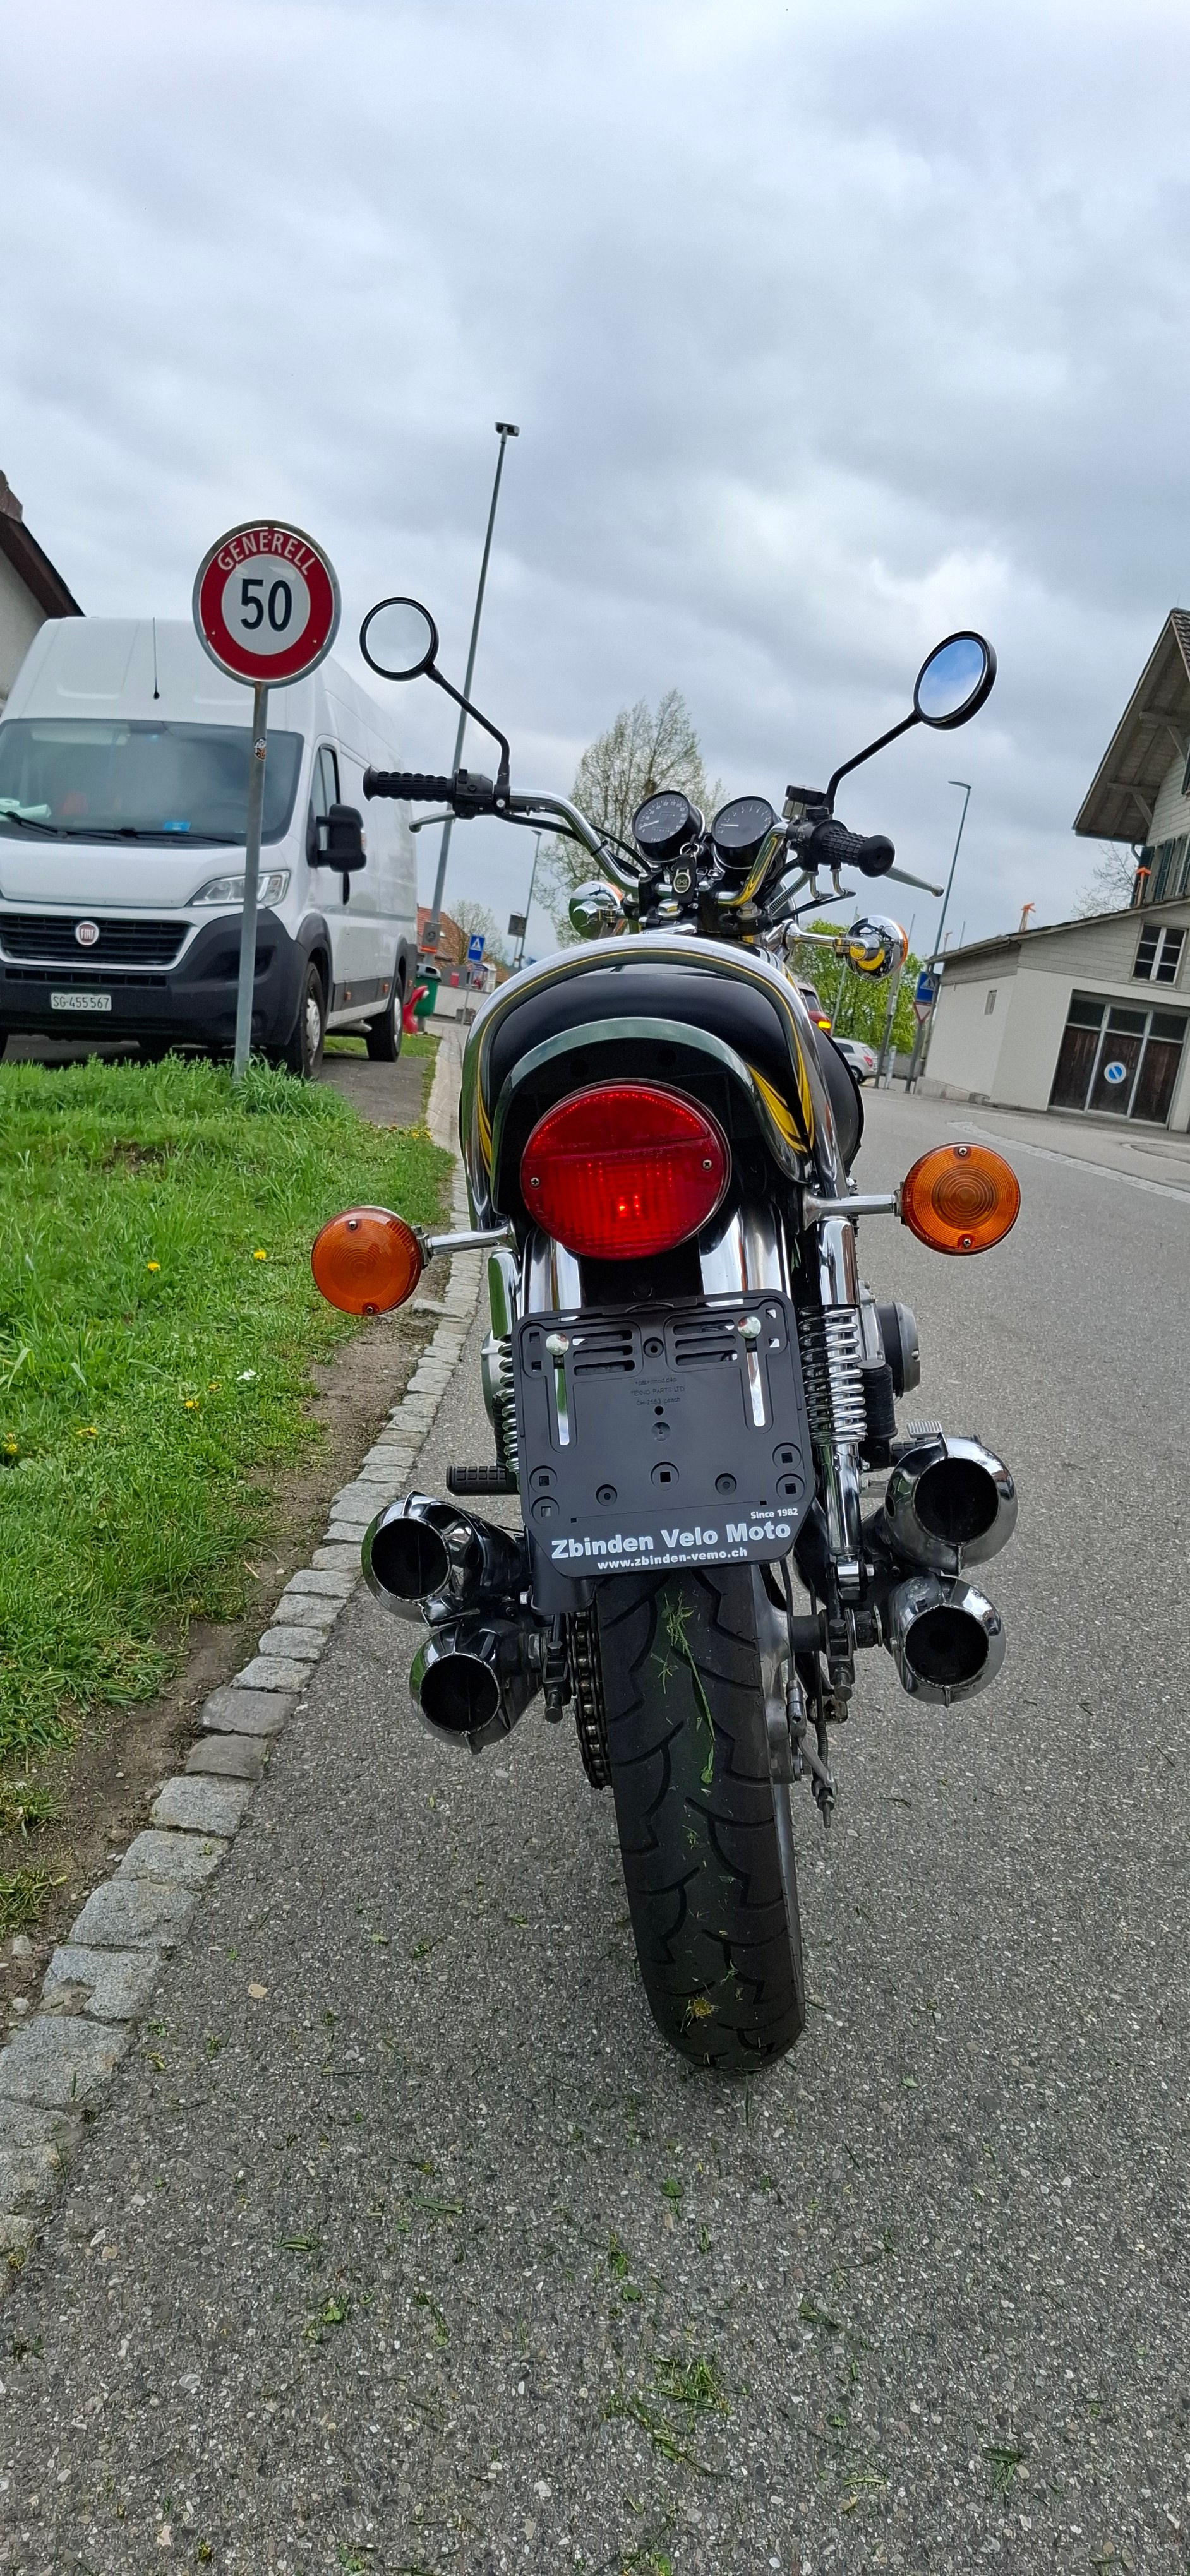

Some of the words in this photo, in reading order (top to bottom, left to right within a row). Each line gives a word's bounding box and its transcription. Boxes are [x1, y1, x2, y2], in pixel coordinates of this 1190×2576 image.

[217, 532, 316, 575] GENERELL
[240, 578, 292, 632] 50
[81, 929, 93, 939] FIAT
[750, 1511, 775, 1520] Since
[777, 1508, 799, 1517] 1982
[551, 1534, 654, 1559] Zbinden
[661, 1527, 718, 1548] Velo
[726, 1521, 791, 1542] Moto
[597, 1547, 748, 1570] www.zbinden-vemo.ch
